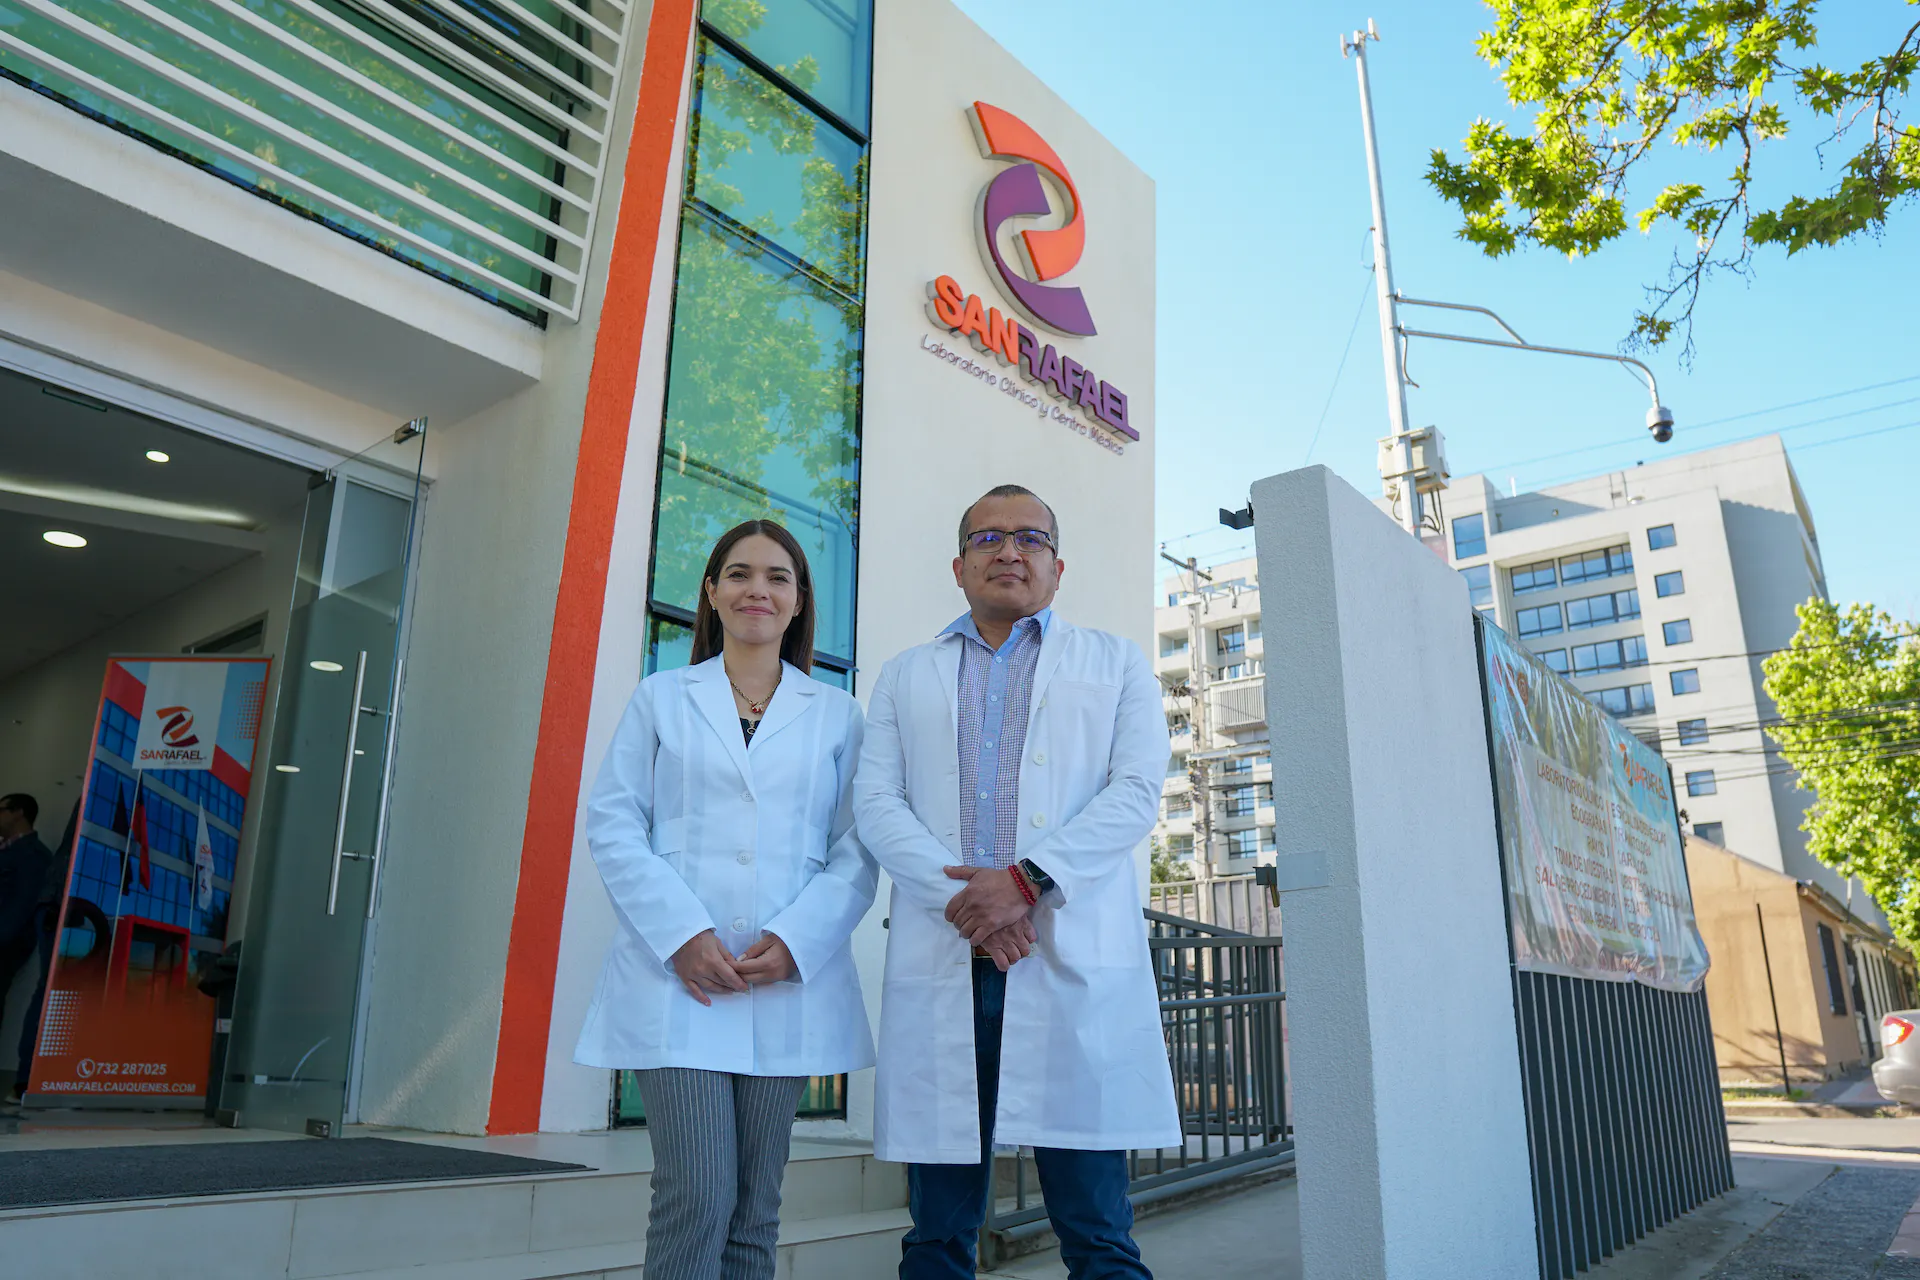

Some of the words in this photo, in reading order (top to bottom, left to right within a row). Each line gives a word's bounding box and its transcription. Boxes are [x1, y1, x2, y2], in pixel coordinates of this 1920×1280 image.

[920, 334, 997, 386] Laboratorio
[1038, 402, 1049, 419] y
[1051, 406, 1088, 436] Centro
[140, 749, 204, 760] SANRAFAEL
[96, 1062, 118, 1075] 732
[121, 1063, 167, 1076] 287025
[41, 1081, 196, 1093] SANRAFAELCAUQUENES.COM
